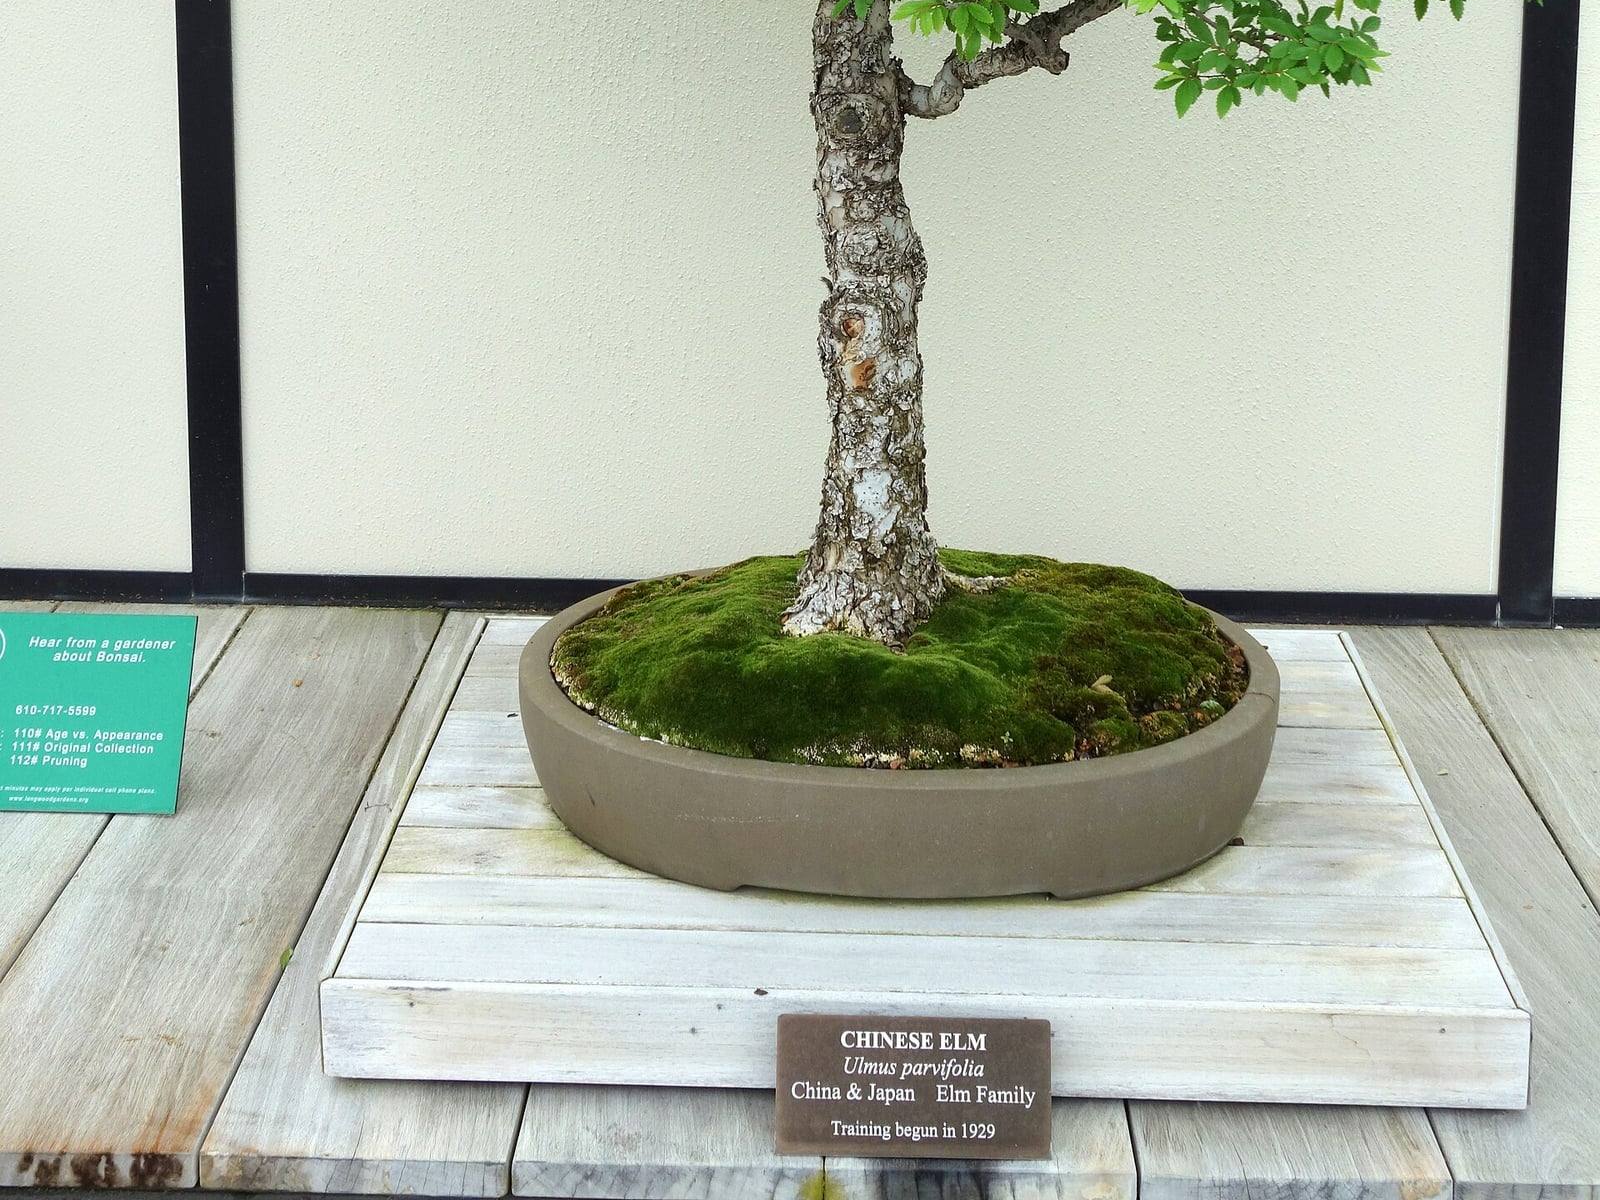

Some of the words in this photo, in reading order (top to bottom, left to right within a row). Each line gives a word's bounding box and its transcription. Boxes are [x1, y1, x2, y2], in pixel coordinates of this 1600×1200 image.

[29, 636, 61, 648] Hear
[66, 636, 96, 649] from
[101, 640, 109, 649] a
[114, 637, 176, 652] gardener
[53, 651, 91, 662] about
[96, 651, 146, 663] Bonsai.
[15, 705, 97, 716] 610-717-5599
[14, 728, 42, 738] 110#
[45, 728, 68, 741] Age
[72, 731, 89, 739] vs.
[94, 729, 163, 741] Appearance
[12, 742, 40, 752] 111#
[44, 742, 91, 754] Original
[95, 743, 154, 754] Collection
[10, 754, 38, 765] 112#
[42, 755, 88, 768] Pruning
[74, 785, 104, 793] individual
[840, 1030, 934, 1050] CHINESE
[939, 1032, 987, 1051] ELM
[843, 1056, 896, 1075] Ulmus
[900, 1059, 985, 1080] parvifolia
[791, 1081, 841, 1100] China
[846, 1082, 862, 1101] &
[867, 1083, 915, 1105] Japan
[936, 1084, 971, 1103] Elm
[976, 1085, 1036, 1108] Family
[831, 1120, 891, 1140] Training
[895, 1120, 938, 1141] begun
[942, 1122, 957, 1139] in
[961, 1122, 996, 1139] 1929
